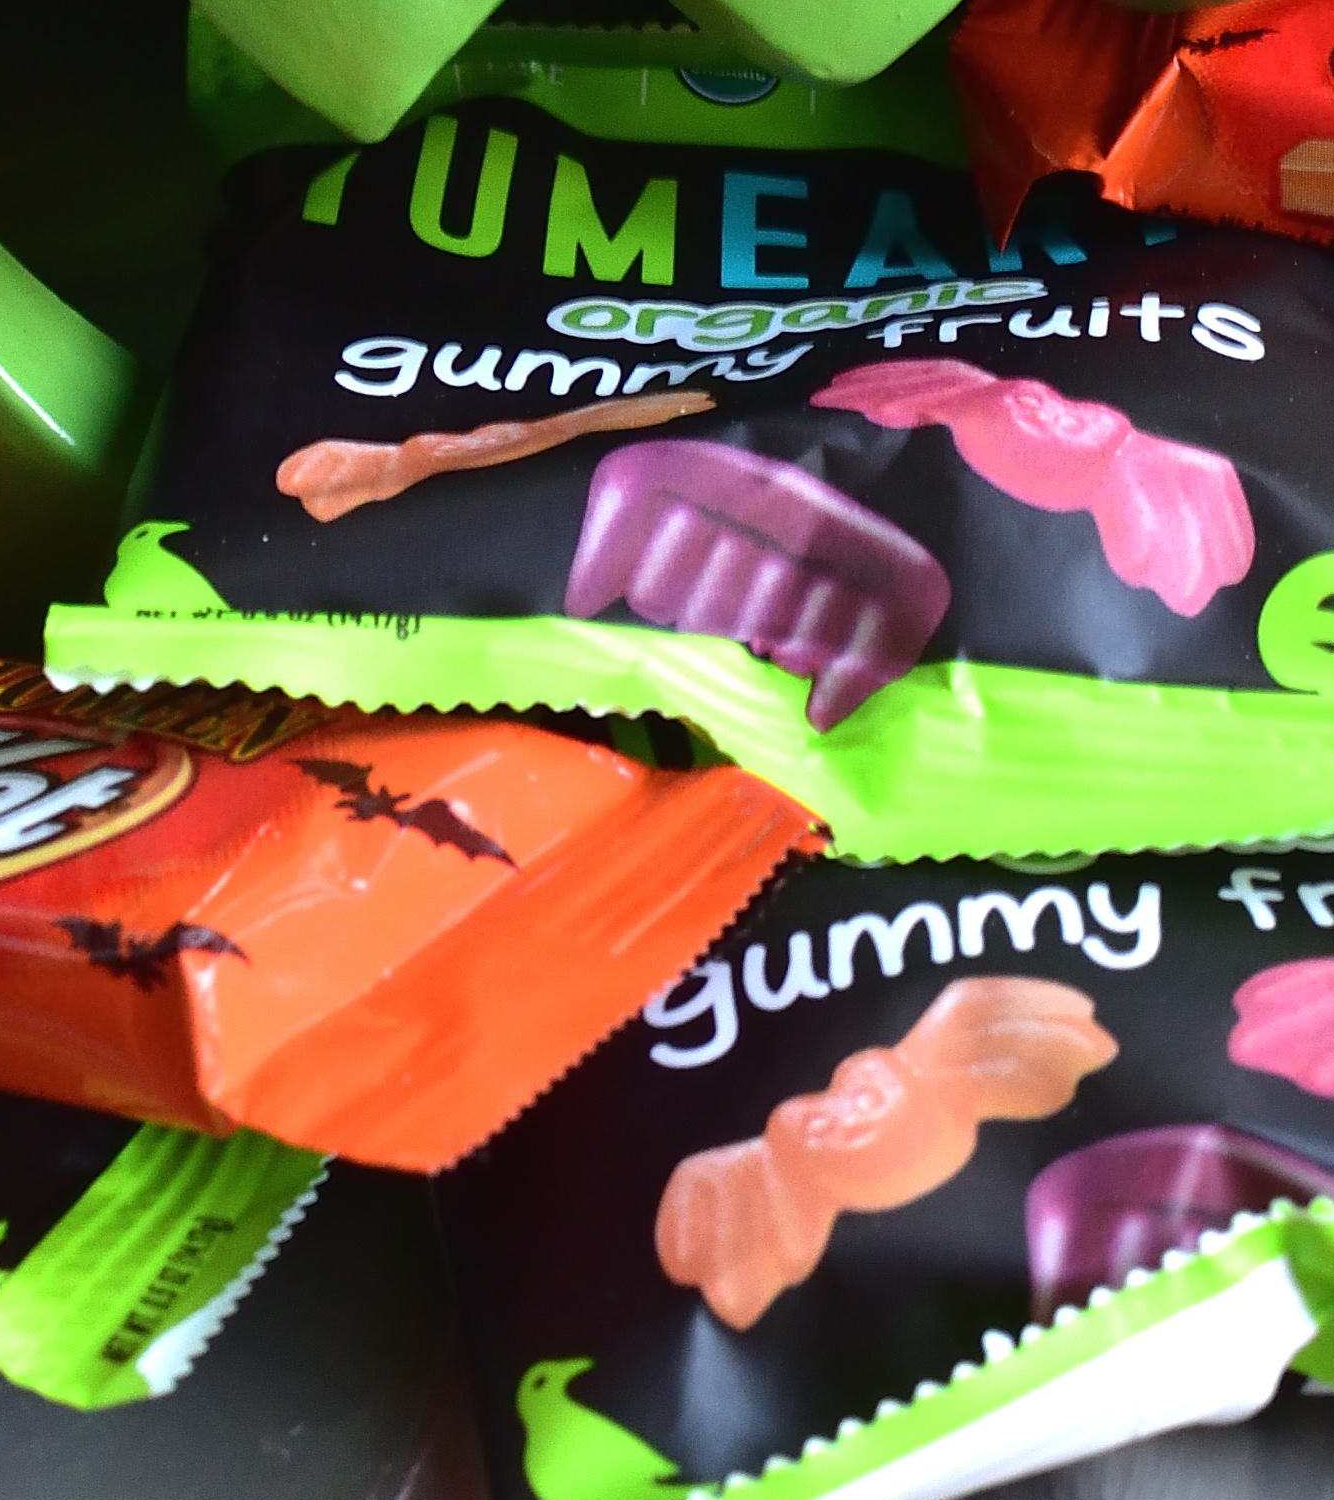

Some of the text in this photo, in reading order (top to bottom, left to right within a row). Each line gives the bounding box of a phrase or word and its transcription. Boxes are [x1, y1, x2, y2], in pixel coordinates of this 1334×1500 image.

[335, 290, 1266, 398] gummy fruits
[547, 279, 1050, 353] organic
[646, 880, 1165, 1070] gummy
